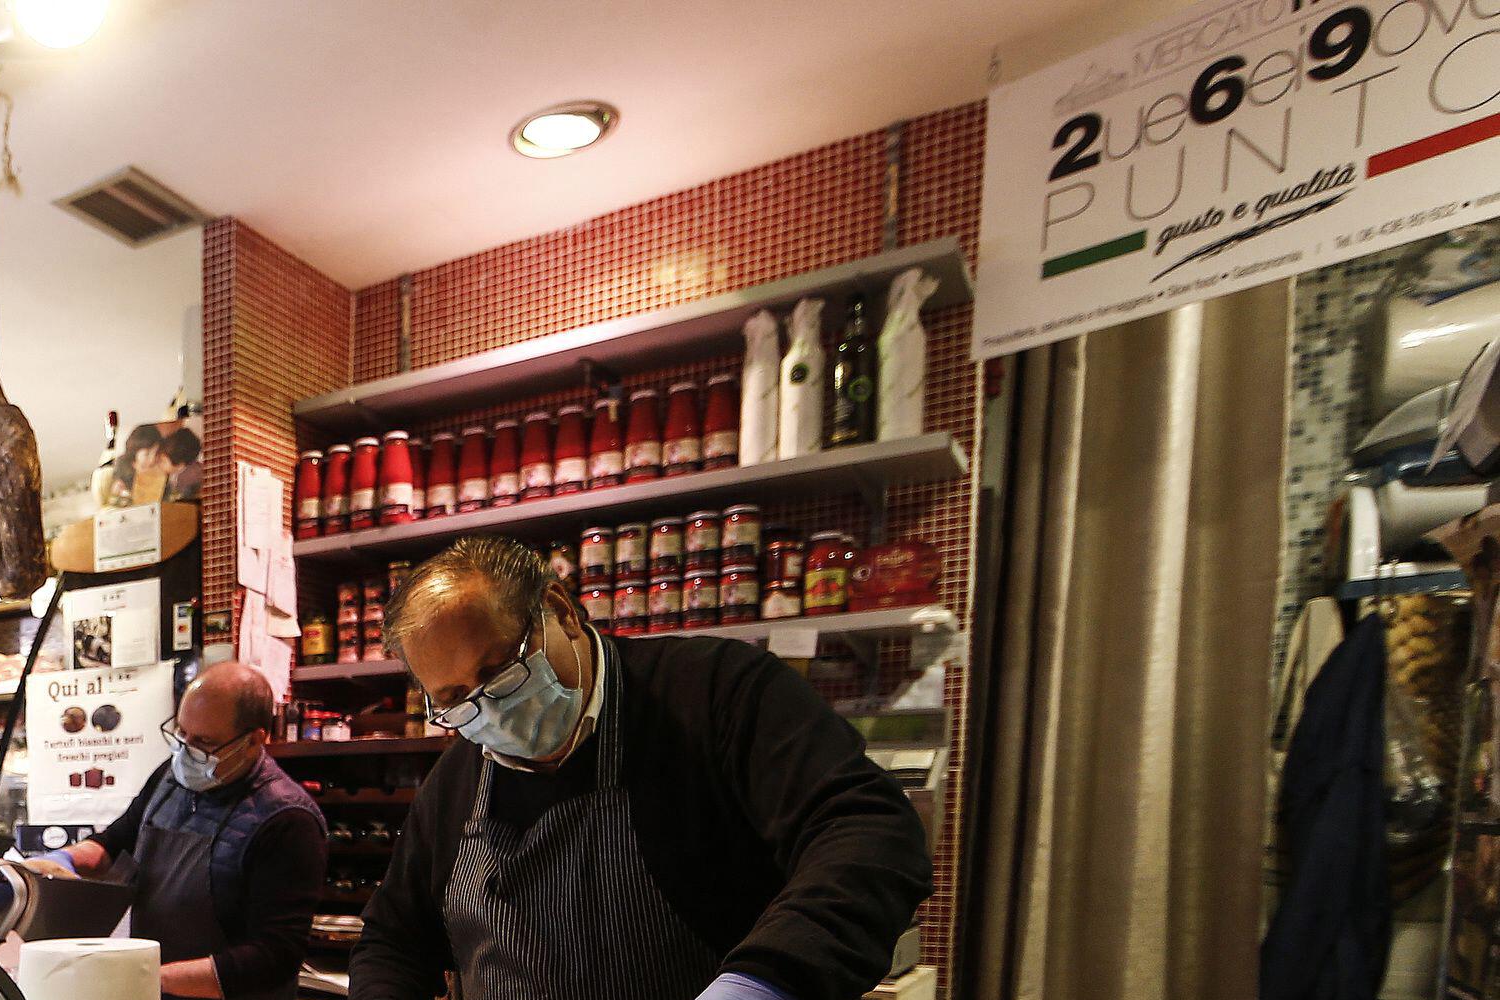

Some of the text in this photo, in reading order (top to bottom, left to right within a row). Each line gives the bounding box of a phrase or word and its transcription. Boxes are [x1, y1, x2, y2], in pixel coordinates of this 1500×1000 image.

[1153, 160, 1357, 256] gusto e qualità
[48, 678, 79, 702] Qui
